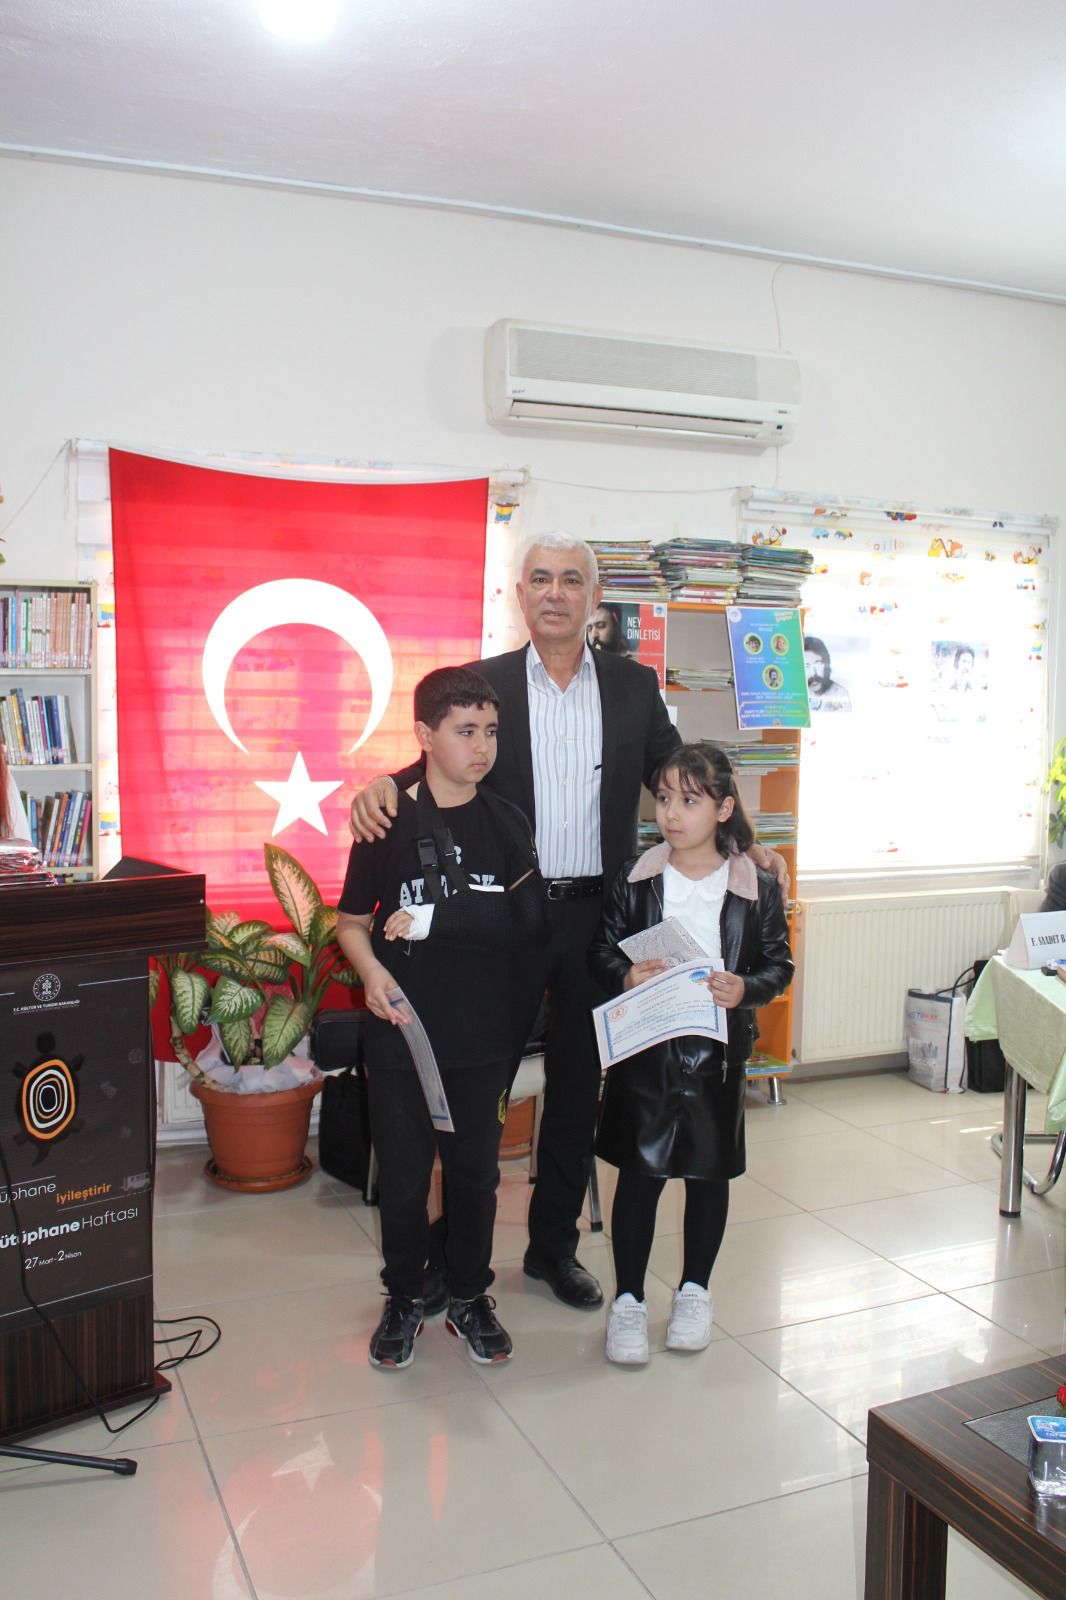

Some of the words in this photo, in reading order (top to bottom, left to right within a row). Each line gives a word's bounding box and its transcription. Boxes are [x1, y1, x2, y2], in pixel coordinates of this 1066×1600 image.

[627, 617, 641, 627] NEY
[627, 627, 660, 640] DİNLETİSİ
[56, 1183, 112, 1206] iyileştirir
[82, 1207, 138, 1230] Haftası
